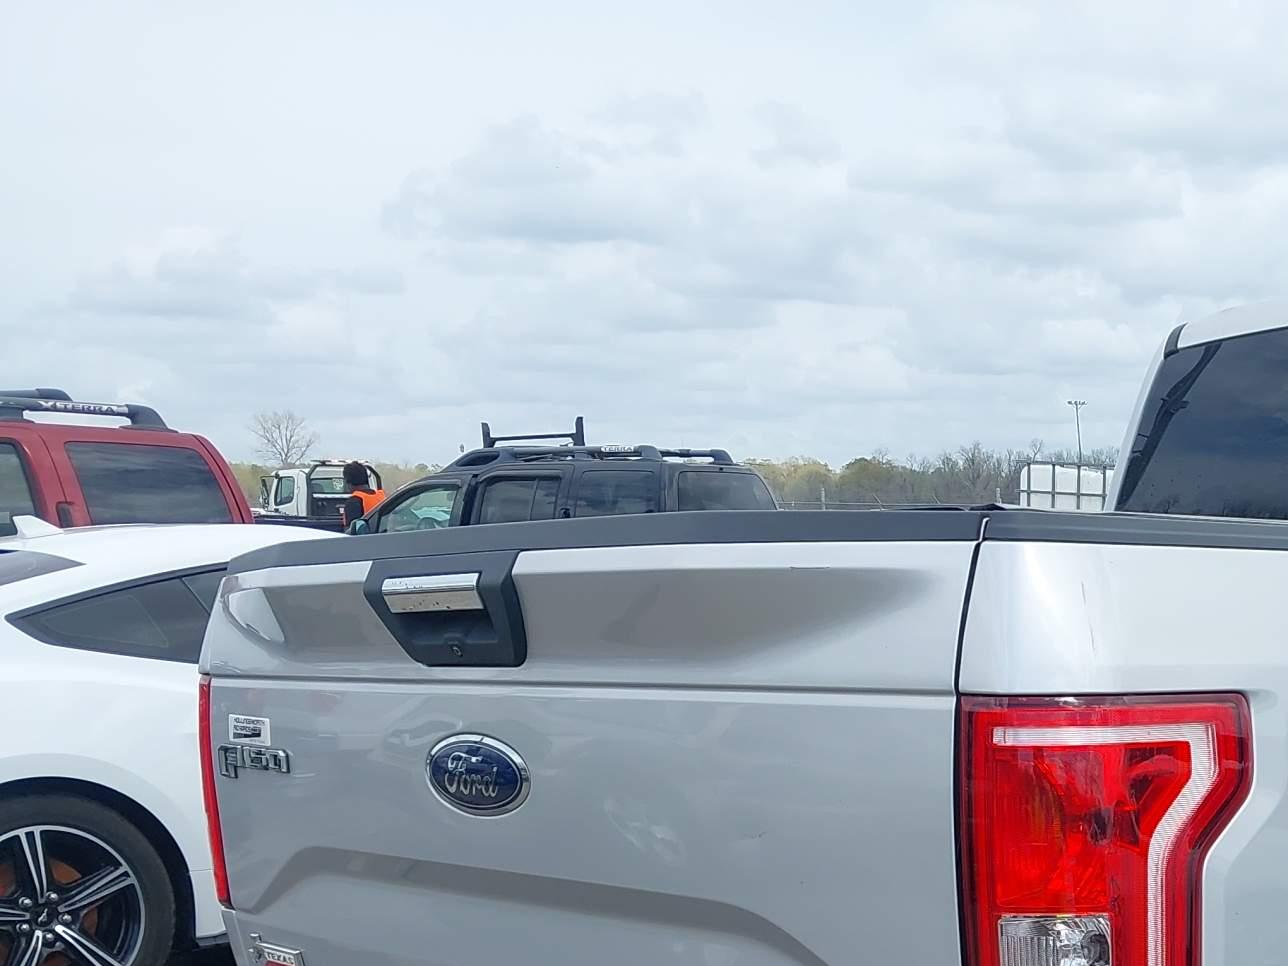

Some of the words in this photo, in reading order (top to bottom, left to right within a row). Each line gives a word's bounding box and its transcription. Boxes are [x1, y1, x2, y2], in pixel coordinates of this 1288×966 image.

[38, 400, 117, 414] XTERRA
[444, 751, 499, 798] Ford
[264, 949, 296, 966] TEXAS
